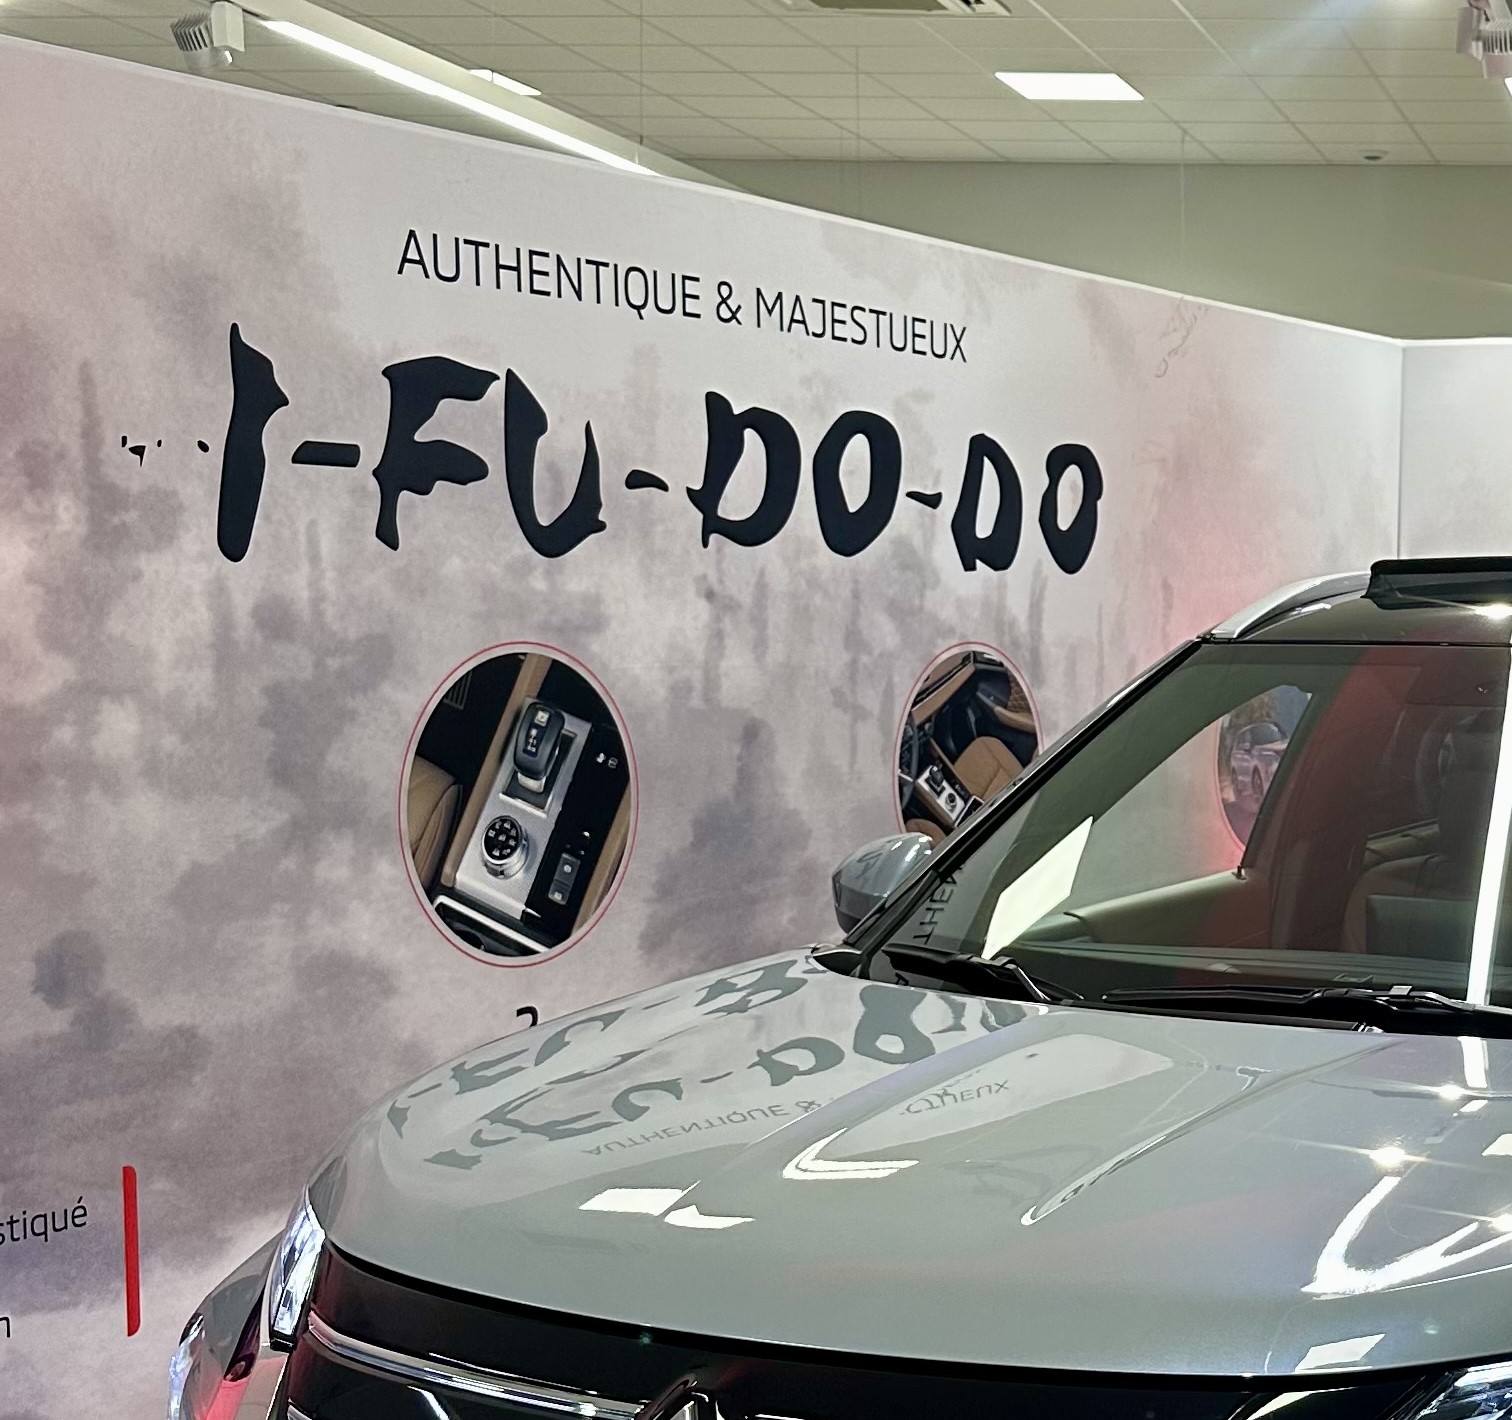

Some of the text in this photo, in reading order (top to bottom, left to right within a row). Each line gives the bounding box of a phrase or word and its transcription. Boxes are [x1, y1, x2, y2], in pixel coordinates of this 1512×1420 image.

[397, 229, 967, 363] AUTHENTIQUE & MAJESTUEUX
